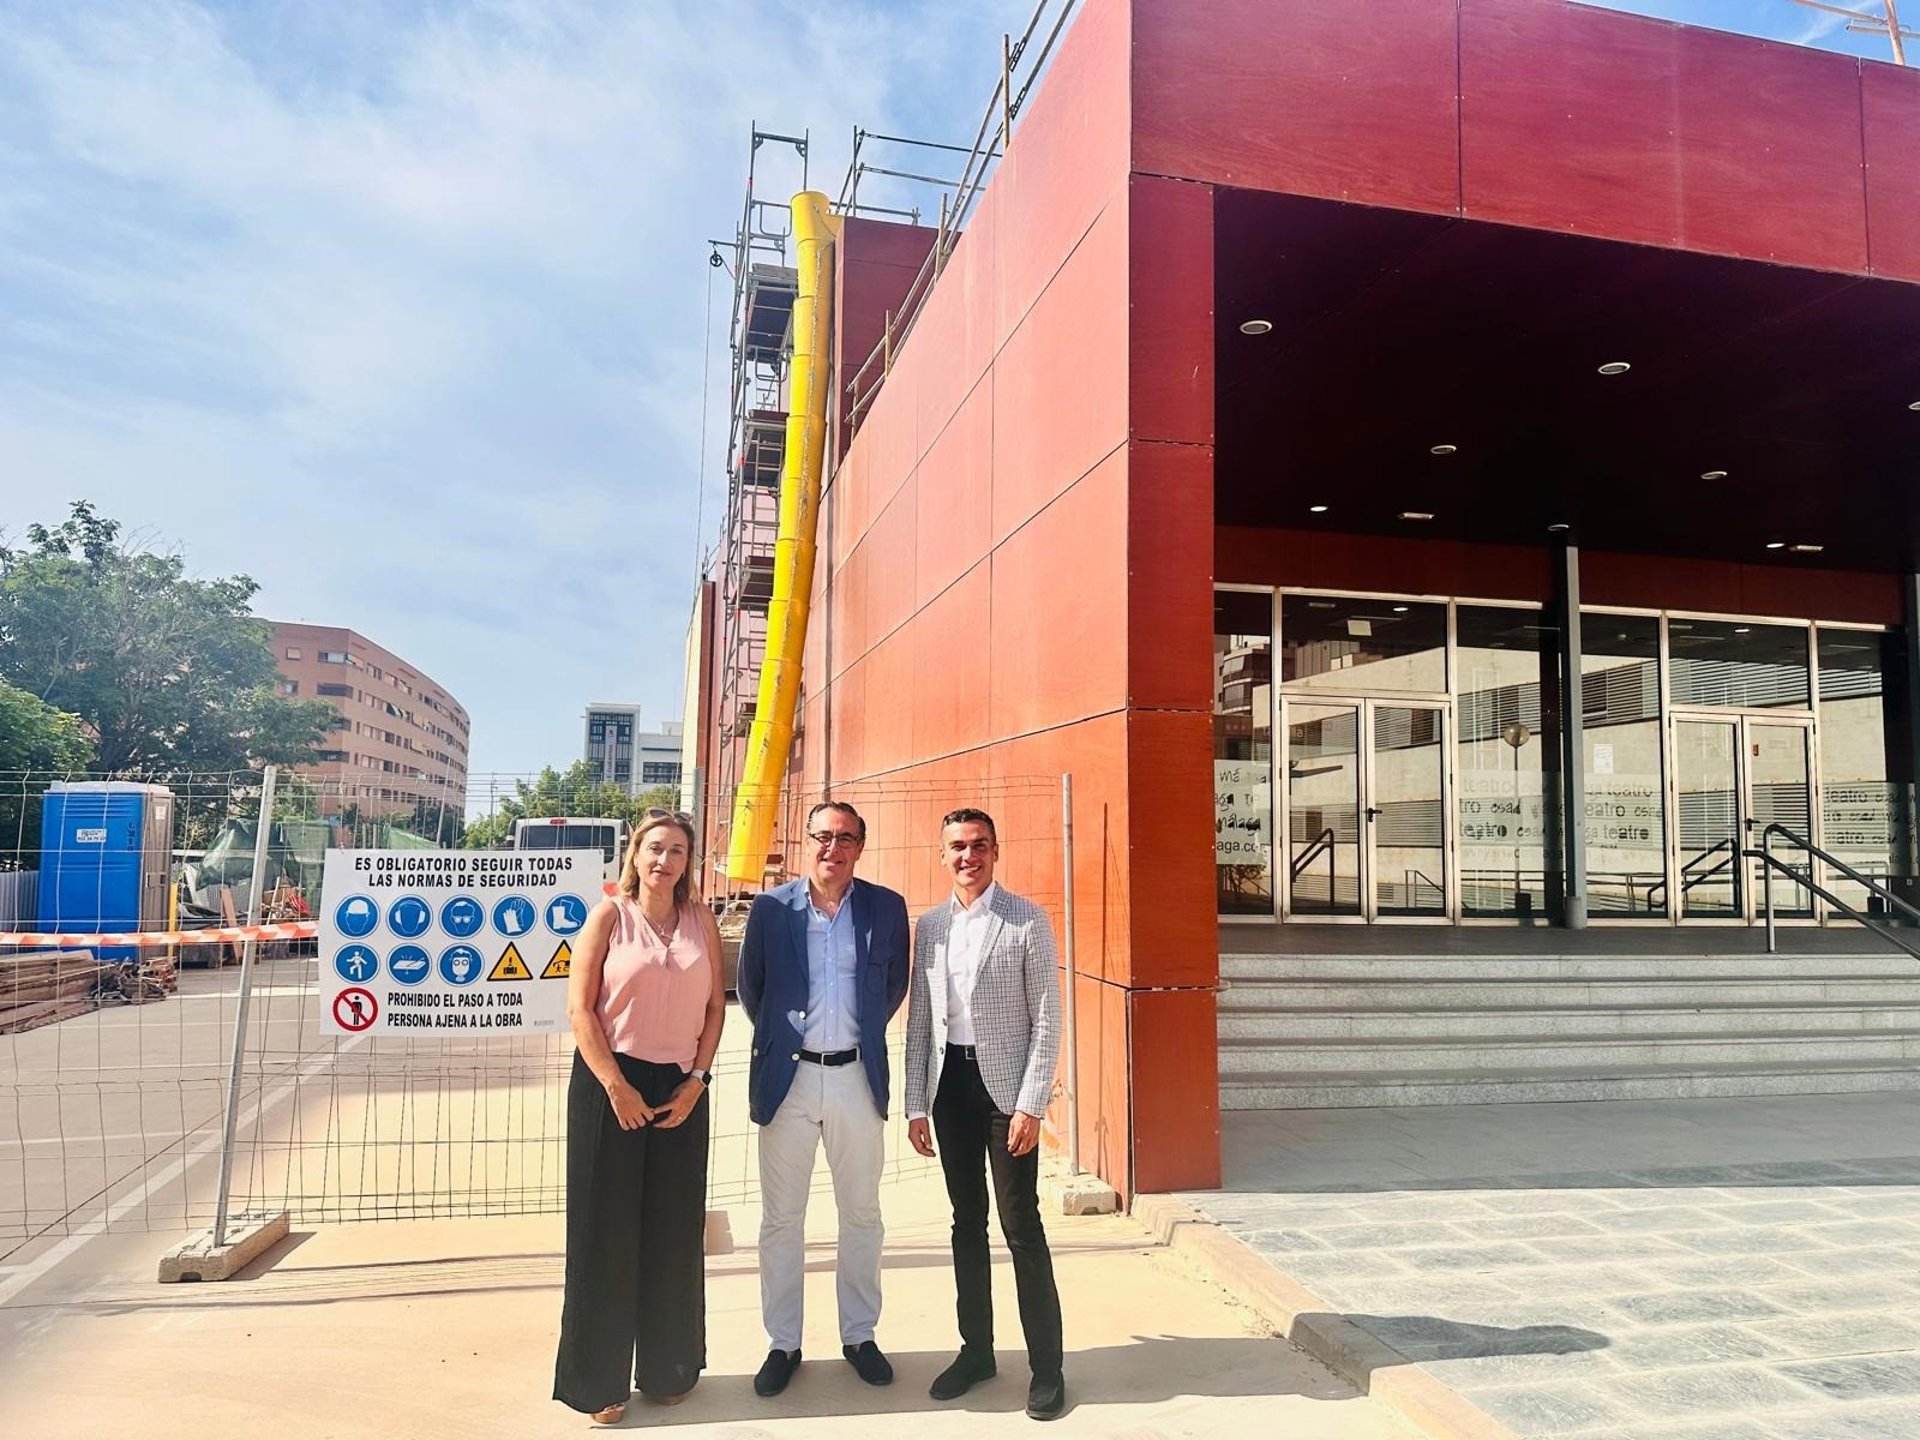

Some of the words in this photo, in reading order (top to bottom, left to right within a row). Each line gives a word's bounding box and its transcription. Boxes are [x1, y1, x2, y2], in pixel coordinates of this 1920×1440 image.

[1603, 825, 1649, 840] teatro
[354, 857, 371, 870] ES
[376, 857, 467, 871] OBLIGATORIO
[471, 858, 523, 871] SEGUIR
[528, 857, 572, 870] TODAS
[368, 874, 393, 887] LAS
[397, 874, 453, 888] NORMAS
[458, 874, 475, 887] DE
[479, 873, 557, 887] SEGURIDAD
[387, 992, 441, 1007] PROHIBIDO
[443, 993, 456, 1007] EL
[458, 994, 484, 1008] PASO
[486, 993, 494, 1006] A
[497, 992, 523, 1006] TODA
[387, 1013, 433, 1028] PERSONA
[435, 1014, 468, 1028] AJENA
[470, 1014, 477, 1027] A
[479, 1014, 493, 1027] LA
[495, 1013, 523, 1027] OBRA
